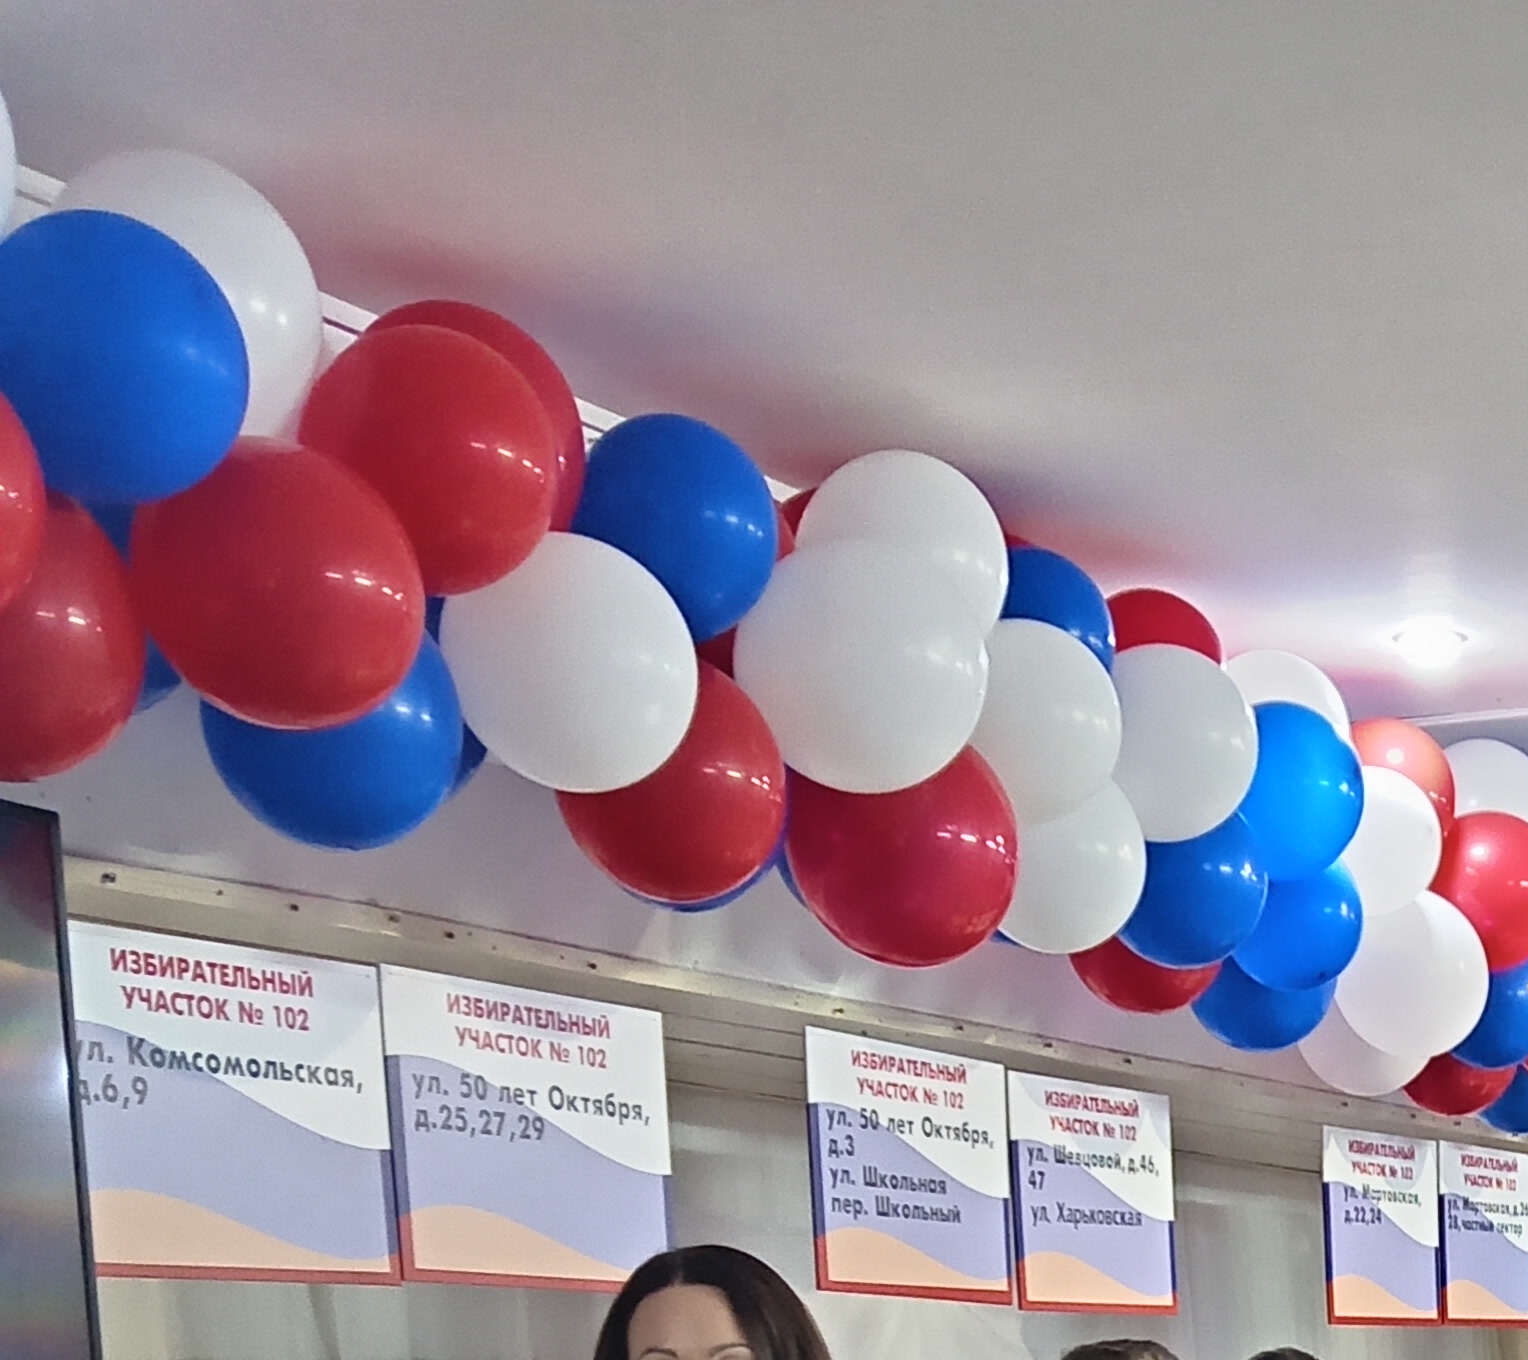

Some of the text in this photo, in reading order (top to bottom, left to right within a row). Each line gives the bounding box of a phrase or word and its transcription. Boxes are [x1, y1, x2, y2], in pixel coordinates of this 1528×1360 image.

[110, 947, 314, 998] ИЗБИРАТЕЛЬНЫЙ
[121, 985, 310, 1031] УЧАСТОК № 102
[447, 992, 610, 1039] ИЗБИРАТЕЛЬНЫЙ
[455, 1026, 607, 1068] УЧАСТОК № 102
[126, 1035, 363, 1094] Комсомольская,
[851, 1050, 967, 1083] ИЗБИРАТЕЛЬНЫЙ
[412, 1073, 650, 1126] ул. 50 лет Октября,
[857, 1077, 964, 1109] УЧАСТОК № 102
[1044, 1090, 1139, 1118] ИЗБИРАТЕЛЬНЫЙ
[415, 1104, 545, 1142] д.25,27,29
[826, 1107, 994, 1149] ул. 50 лет Октября,
[1050, 1115, 1100, 1136] УЧАСТОК
[1119, 1124, 1137, 1141] 102
[828, 1135, 855, 1158] д.3
[1027, 1146, 1049, 1167] ул.
[829, 1165, 947, 1195] ул. Школьная
[1028, 1170, 1045, 1190] 47
[831, 1195, 961, 1224] пер. Школьный
[1056, 1201, 1143, 1230] Харьковская
